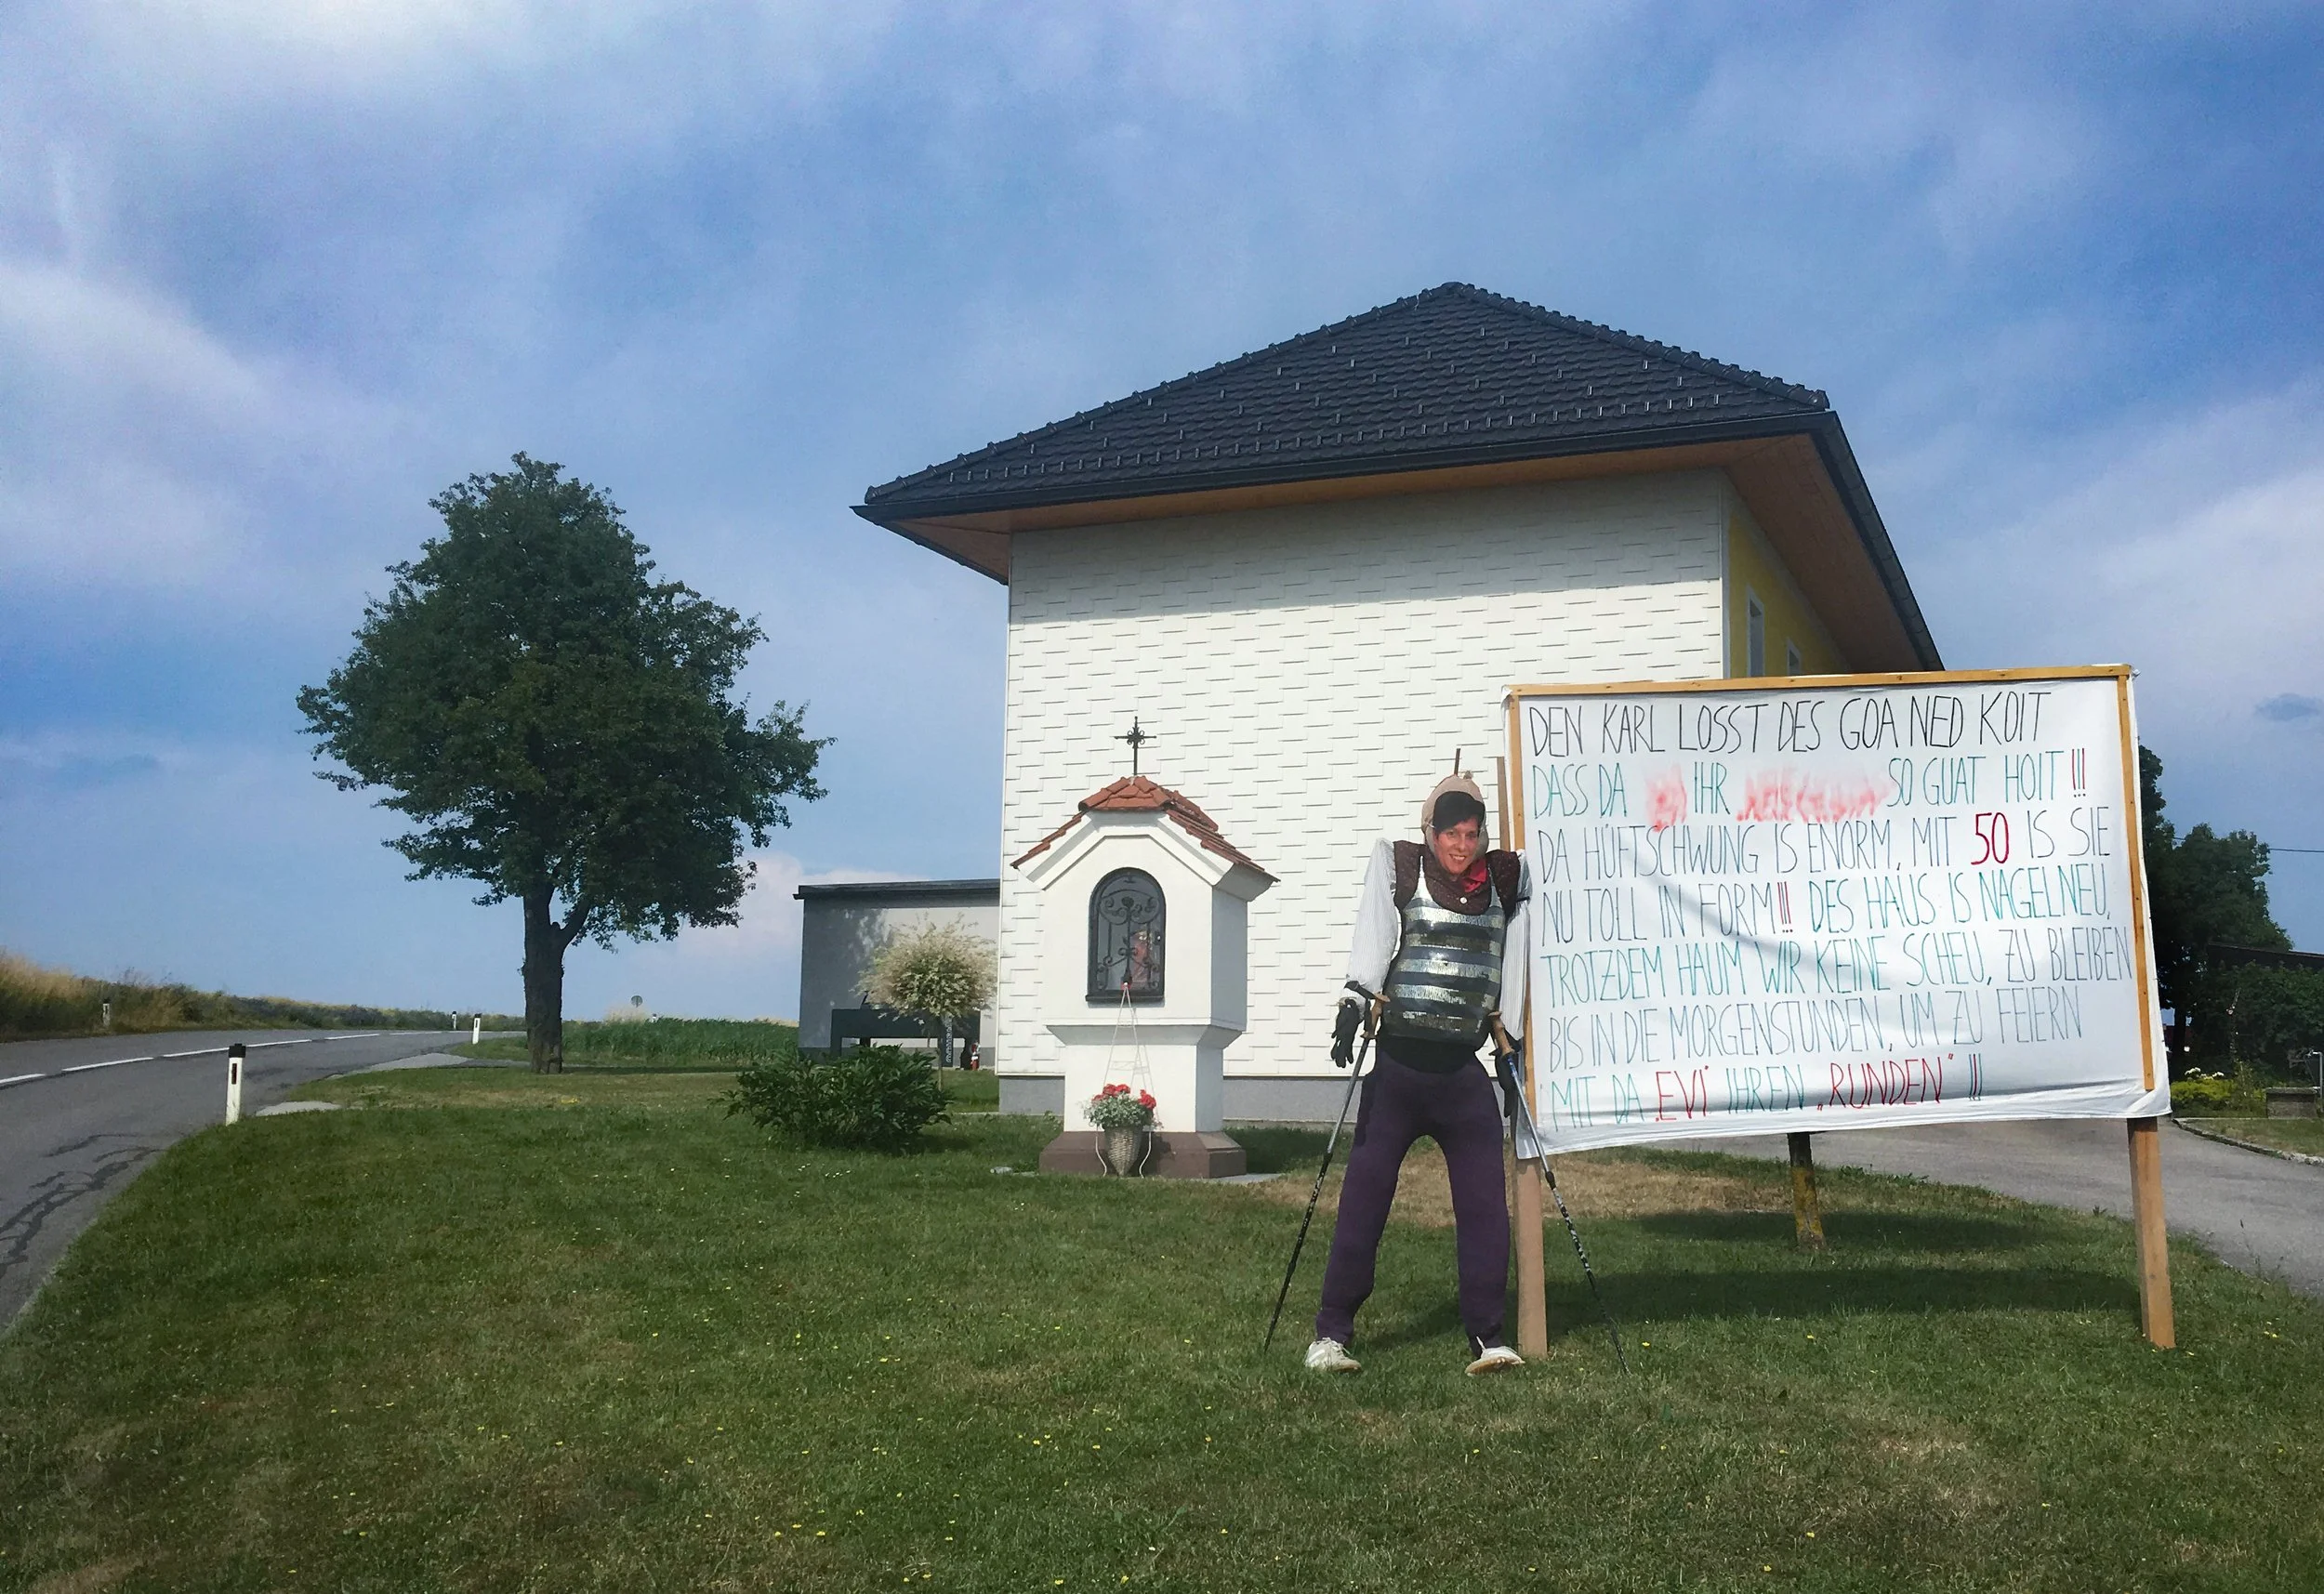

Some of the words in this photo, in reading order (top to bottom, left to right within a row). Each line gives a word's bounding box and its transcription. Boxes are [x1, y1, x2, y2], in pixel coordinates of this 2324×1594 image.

[1529, 705, 1583, 757] DEN
[1602, 703, 1666, 754] KARL
[1679, 704, 1769, 754] LOSST
[1777, 700, 1825, 753] DES
[1840, 697, 1899, 751] GOA
[1910, 695, 1963, 747] NED
[1979, 691, 2052, 745] KOIT
[1533, 763, 1589, 820] DASS
[1599, 761, 1627, 818] DA
[1694, 761, 1731, 815] IHR
[1886, 757, 1913, 807] SO
[1922, 756, 1987, 806] GUAT
[2004, 750, 2065, 803] HOIT
[1538, 828, 1571, 884] DA
[1775, 823, 1798, 875] IS
[1807, 819, 1901, 874] ENORM,
[1912, 816, 1957, 867] MIT
[1971, 811, 2010, 865] 50
[2027, 810, 2055, 859] IS
[2067, 806, 2110, 857] SIE
[1541, 889, 1574, 947] NU
[1583, 886, 1647, 942] TOLL
[1657, 883, 1685, 939] IN
[1808, 877, 1855, 933] DES
[1863, 872, 1936, 929] HAUS
[1948, 871, 1972, 923] IS
[1978, 863, 2111, 922] NAGELNEU,
[1539, 945, 1667, 1008] TROTZDEM
[1675, 940, 1747, 996] HAUM
[1754, 940, 1806, 995] WIR
[1814, 935, 1892, 995] KEINE
[1903, 930, 1993, 987] SCHEU,
[1998, 929, 2037, 983] ZU
[2047, 926, 2133, 982] BLEIBEN
[1550, 1015, 1584, 1074] BIS
[1591, 1011, 1617, 1067] IN
[1624, 1008, 1660, 1064] DIE
[1899, 990, 1940, 1048] UM
[1944, 989, 1984, 1046] ZU
[1995, 985, 2082, 1045] FEIERN
[1552, 1074, 1597, 1132] MIT
[1612, 1073, 1645, 1125] DA
[1725, 1064, 1805, 1115] IHREN
